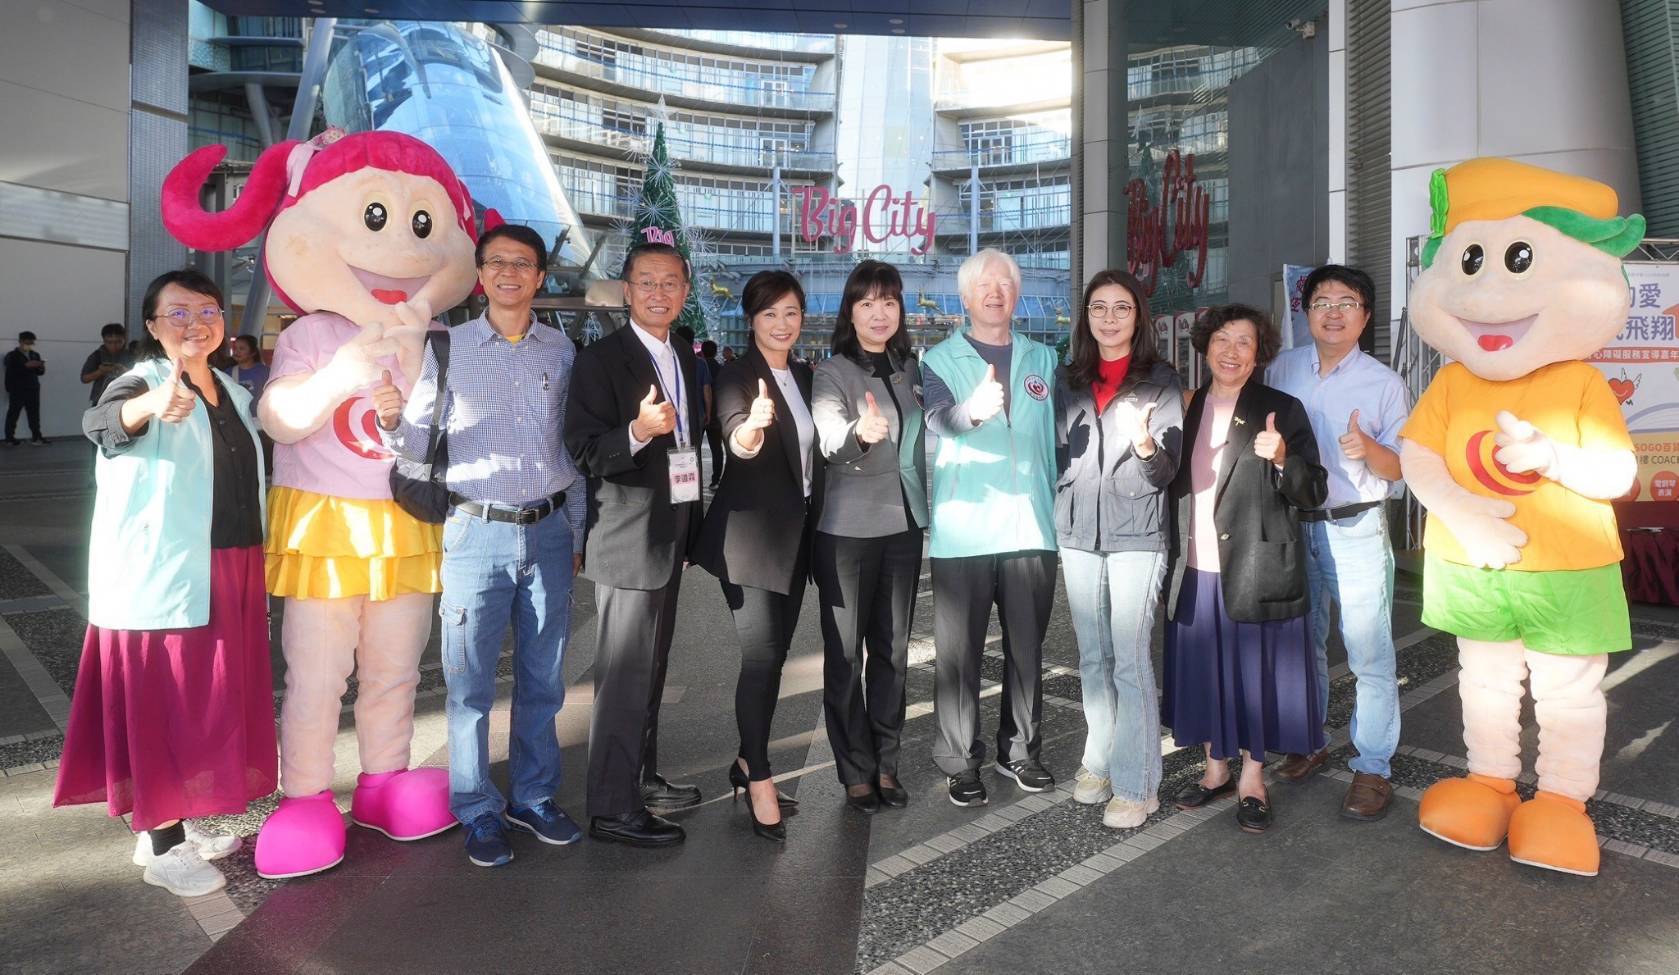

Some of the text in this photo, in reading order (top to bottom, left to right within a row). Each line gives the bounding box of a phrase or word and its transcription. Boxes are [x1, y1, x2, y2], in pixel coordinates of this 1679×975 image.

[790, 184, 936, 256] Big City
[1616, 316, 1674, 340] 飛翔
